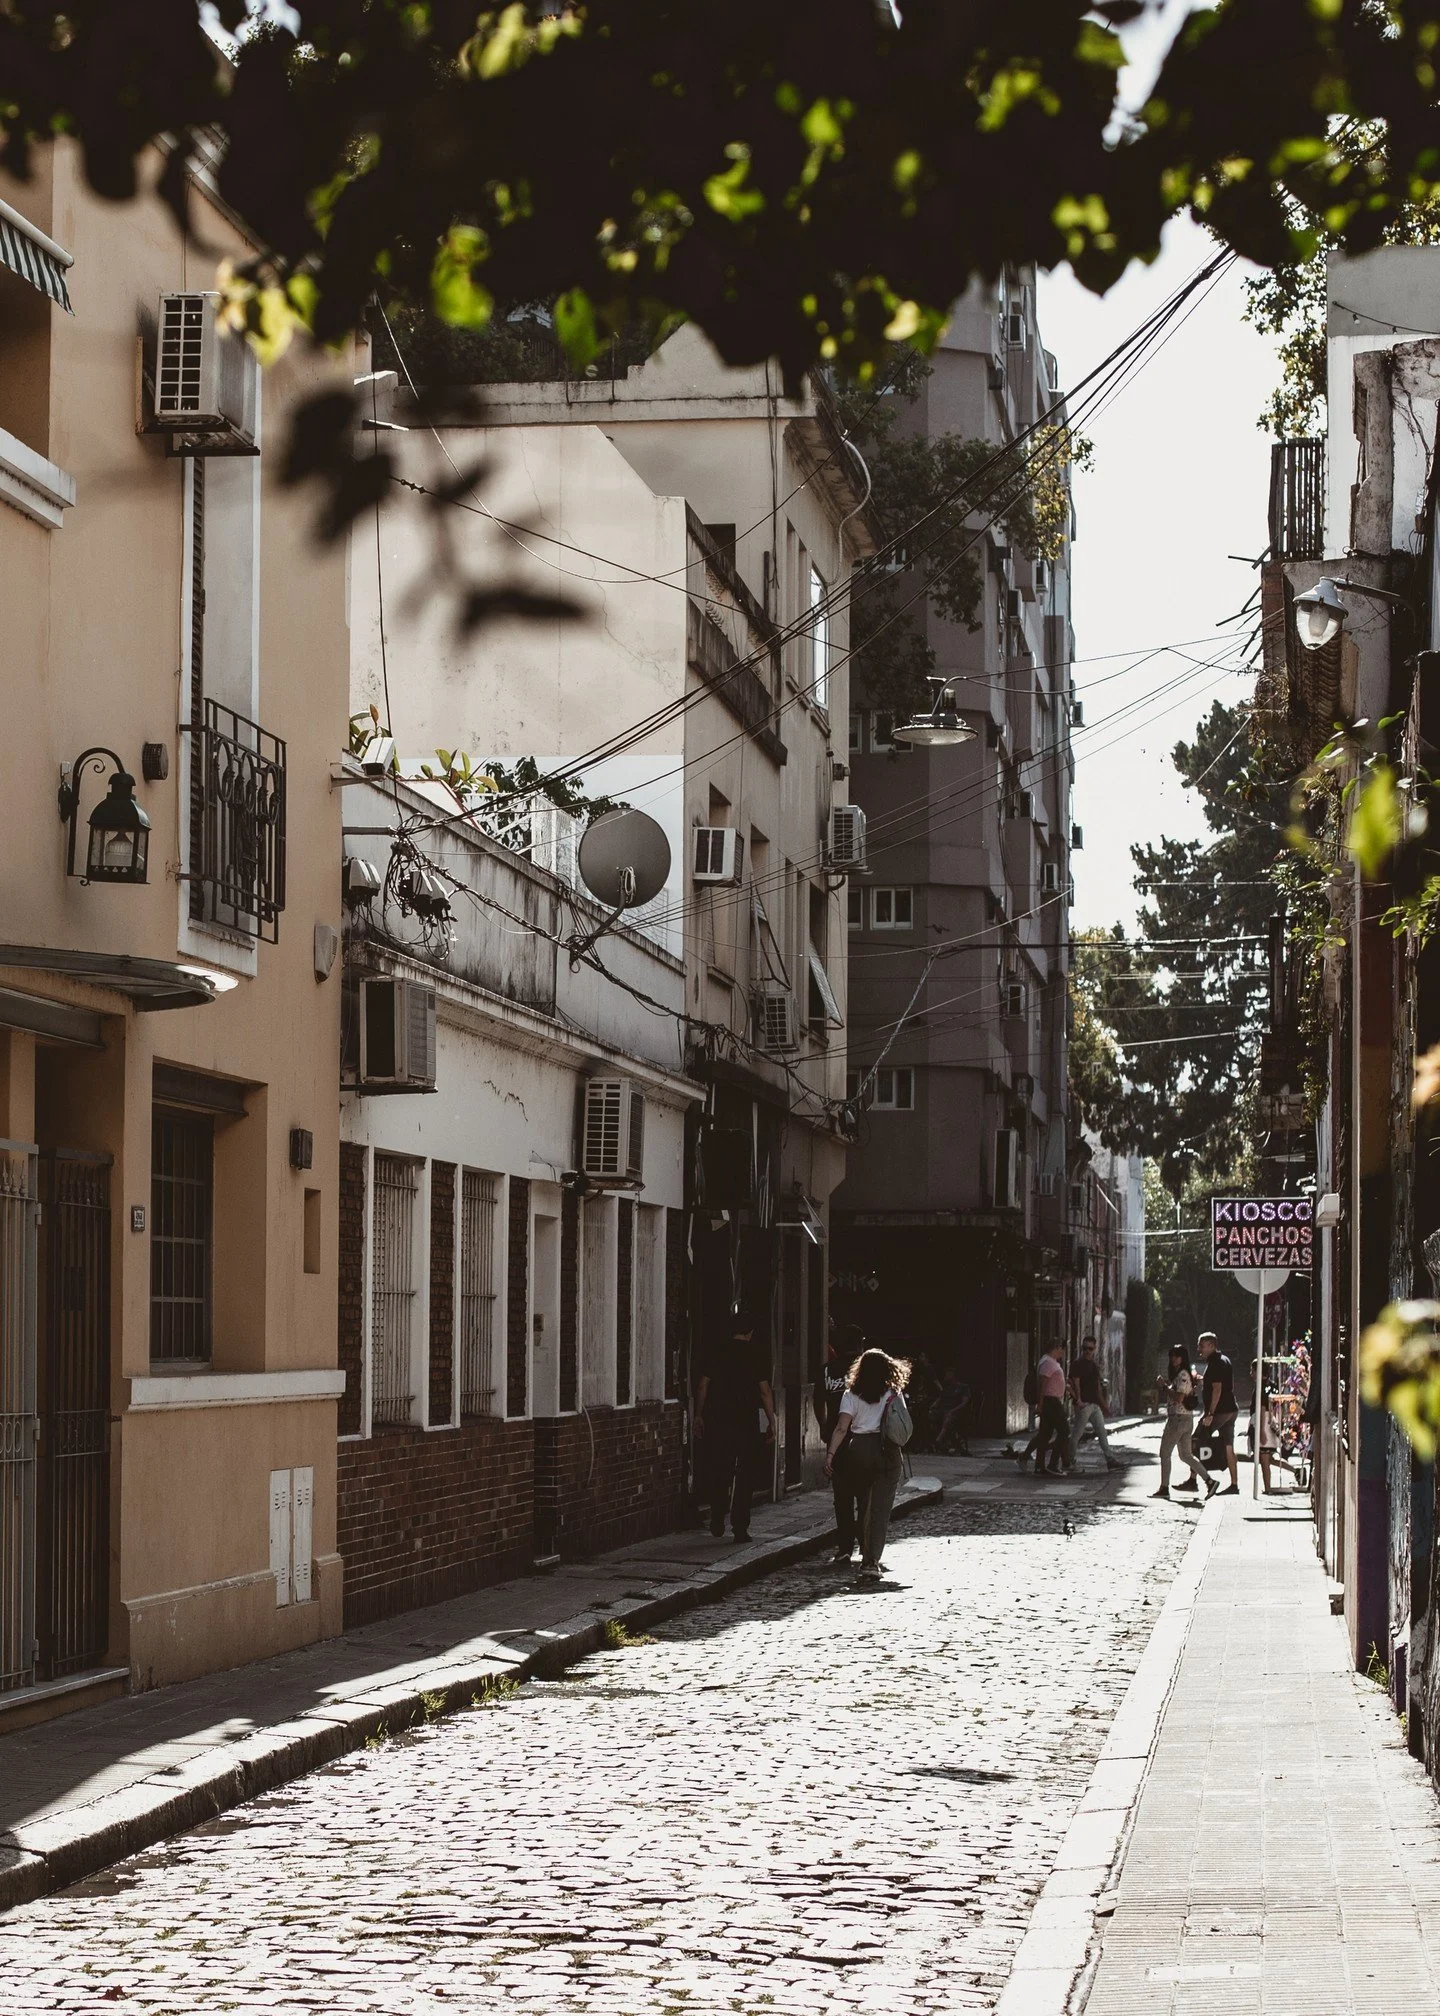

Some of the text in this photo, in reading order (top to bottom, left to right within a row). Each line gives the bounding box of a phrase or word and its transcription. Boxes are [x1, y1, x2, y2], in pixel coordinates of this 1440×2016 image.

[1215, 1202, 1312, 1221] KIOSCO
[1215, 1226, 1313, 1245] PANCHOS
[1216, 1247, 1313, 1266] CERVEZAS
